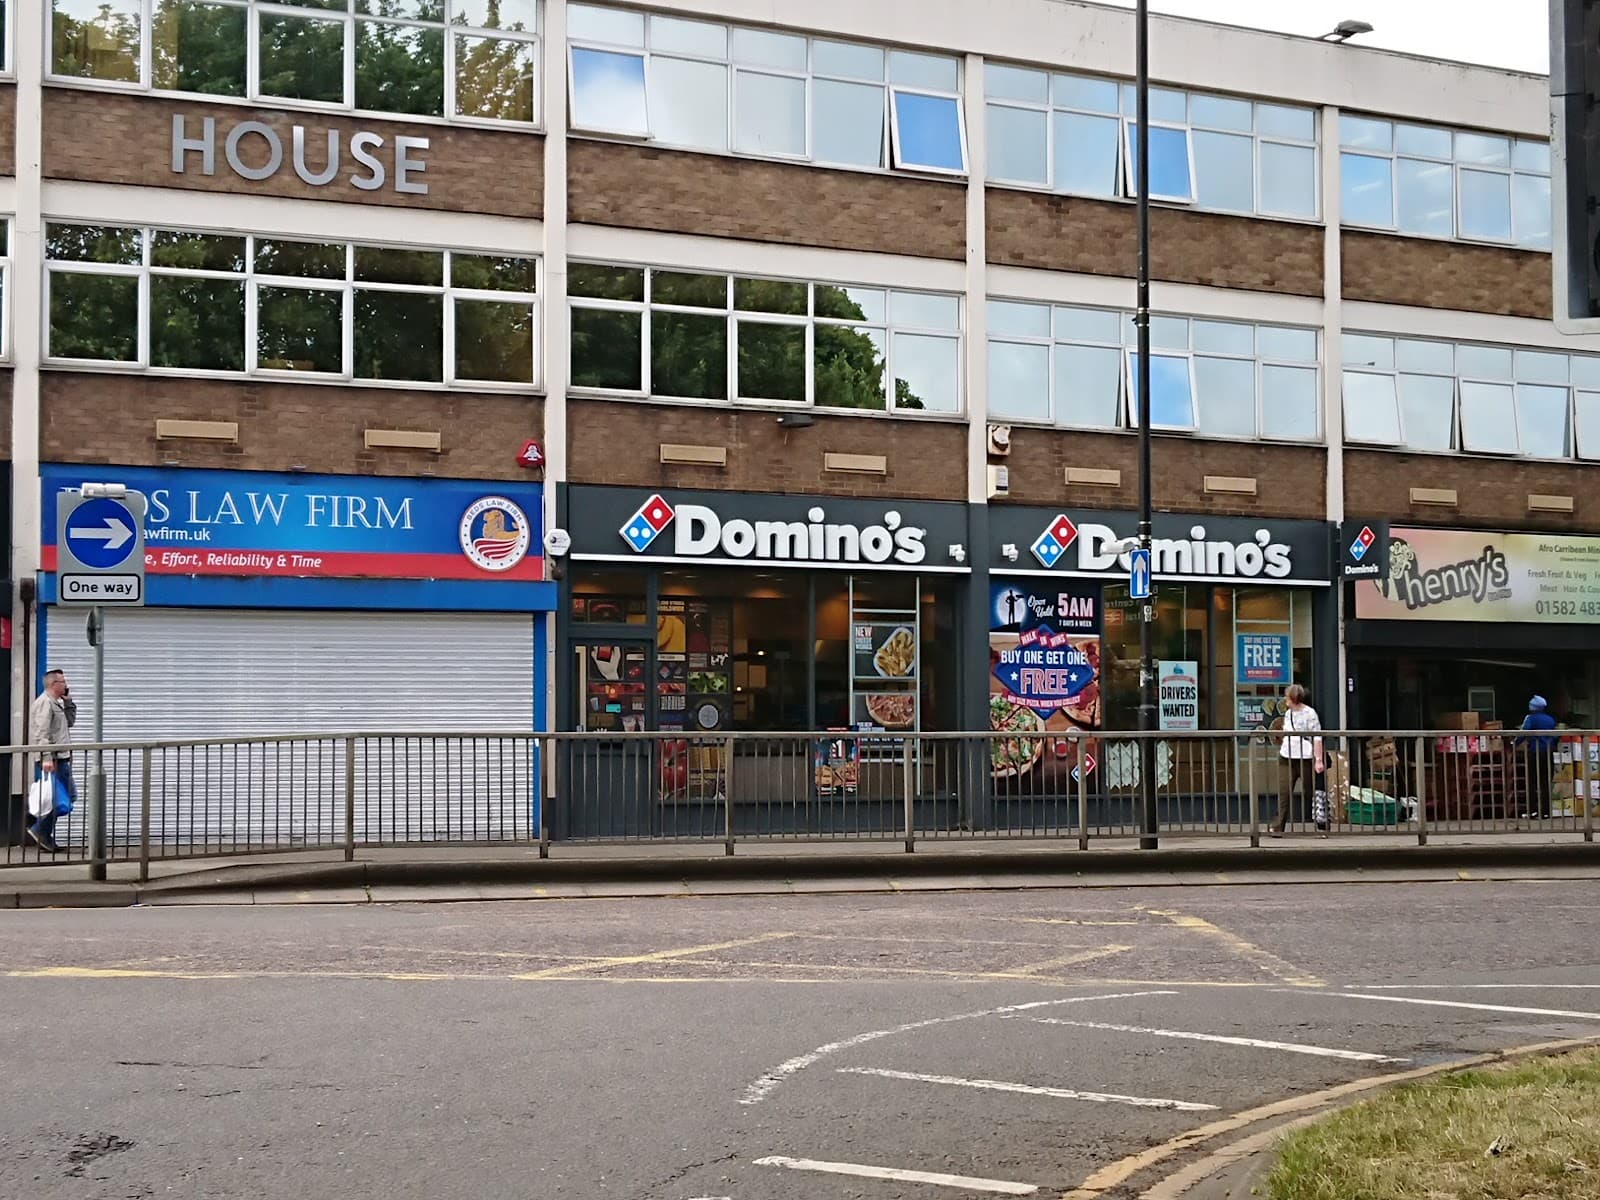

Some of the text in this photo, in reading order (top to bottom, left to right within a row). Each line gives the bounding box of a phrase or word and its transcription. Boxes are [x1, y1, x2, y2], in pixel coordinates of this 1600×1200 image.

[172, 114, 430, 194] HOUSE
[186, 490, 294, 527] LAW
[304, 494, 414, 529] FIRM
[466, 500, 522, 521] BEDS LAW FIRM
[143, 527, 210, 541] awfirm.uk
[674, 504, 926, 563] Domino's
[1538, 544, 1553, 552] Afro
[162, 552, 203, 568] Effort,
[207, 553, 273, 569] Reliability
[277, 557, 287, 567] &
[291, 555, 322, 567] Time
[1345, 564, 1379, 575] Domino's
[1403, 546, 1508, 608] henry's
[69, 581, 133, 595] One way
[1057, 593, 1094, 617] 5AM
[1536, 600, 1576, 615] 01582
[855, 627, 873, 637] NEW
[1001, 650, 1086, 665] BUY ONE GET ONE
[1244, 645, 1282, 667] FREE
[1020, 668, 1069, 695] FREE
[1161, 686, 1196, 700] DRIVERS
[1163, 704, 1195, 717] WANTED
